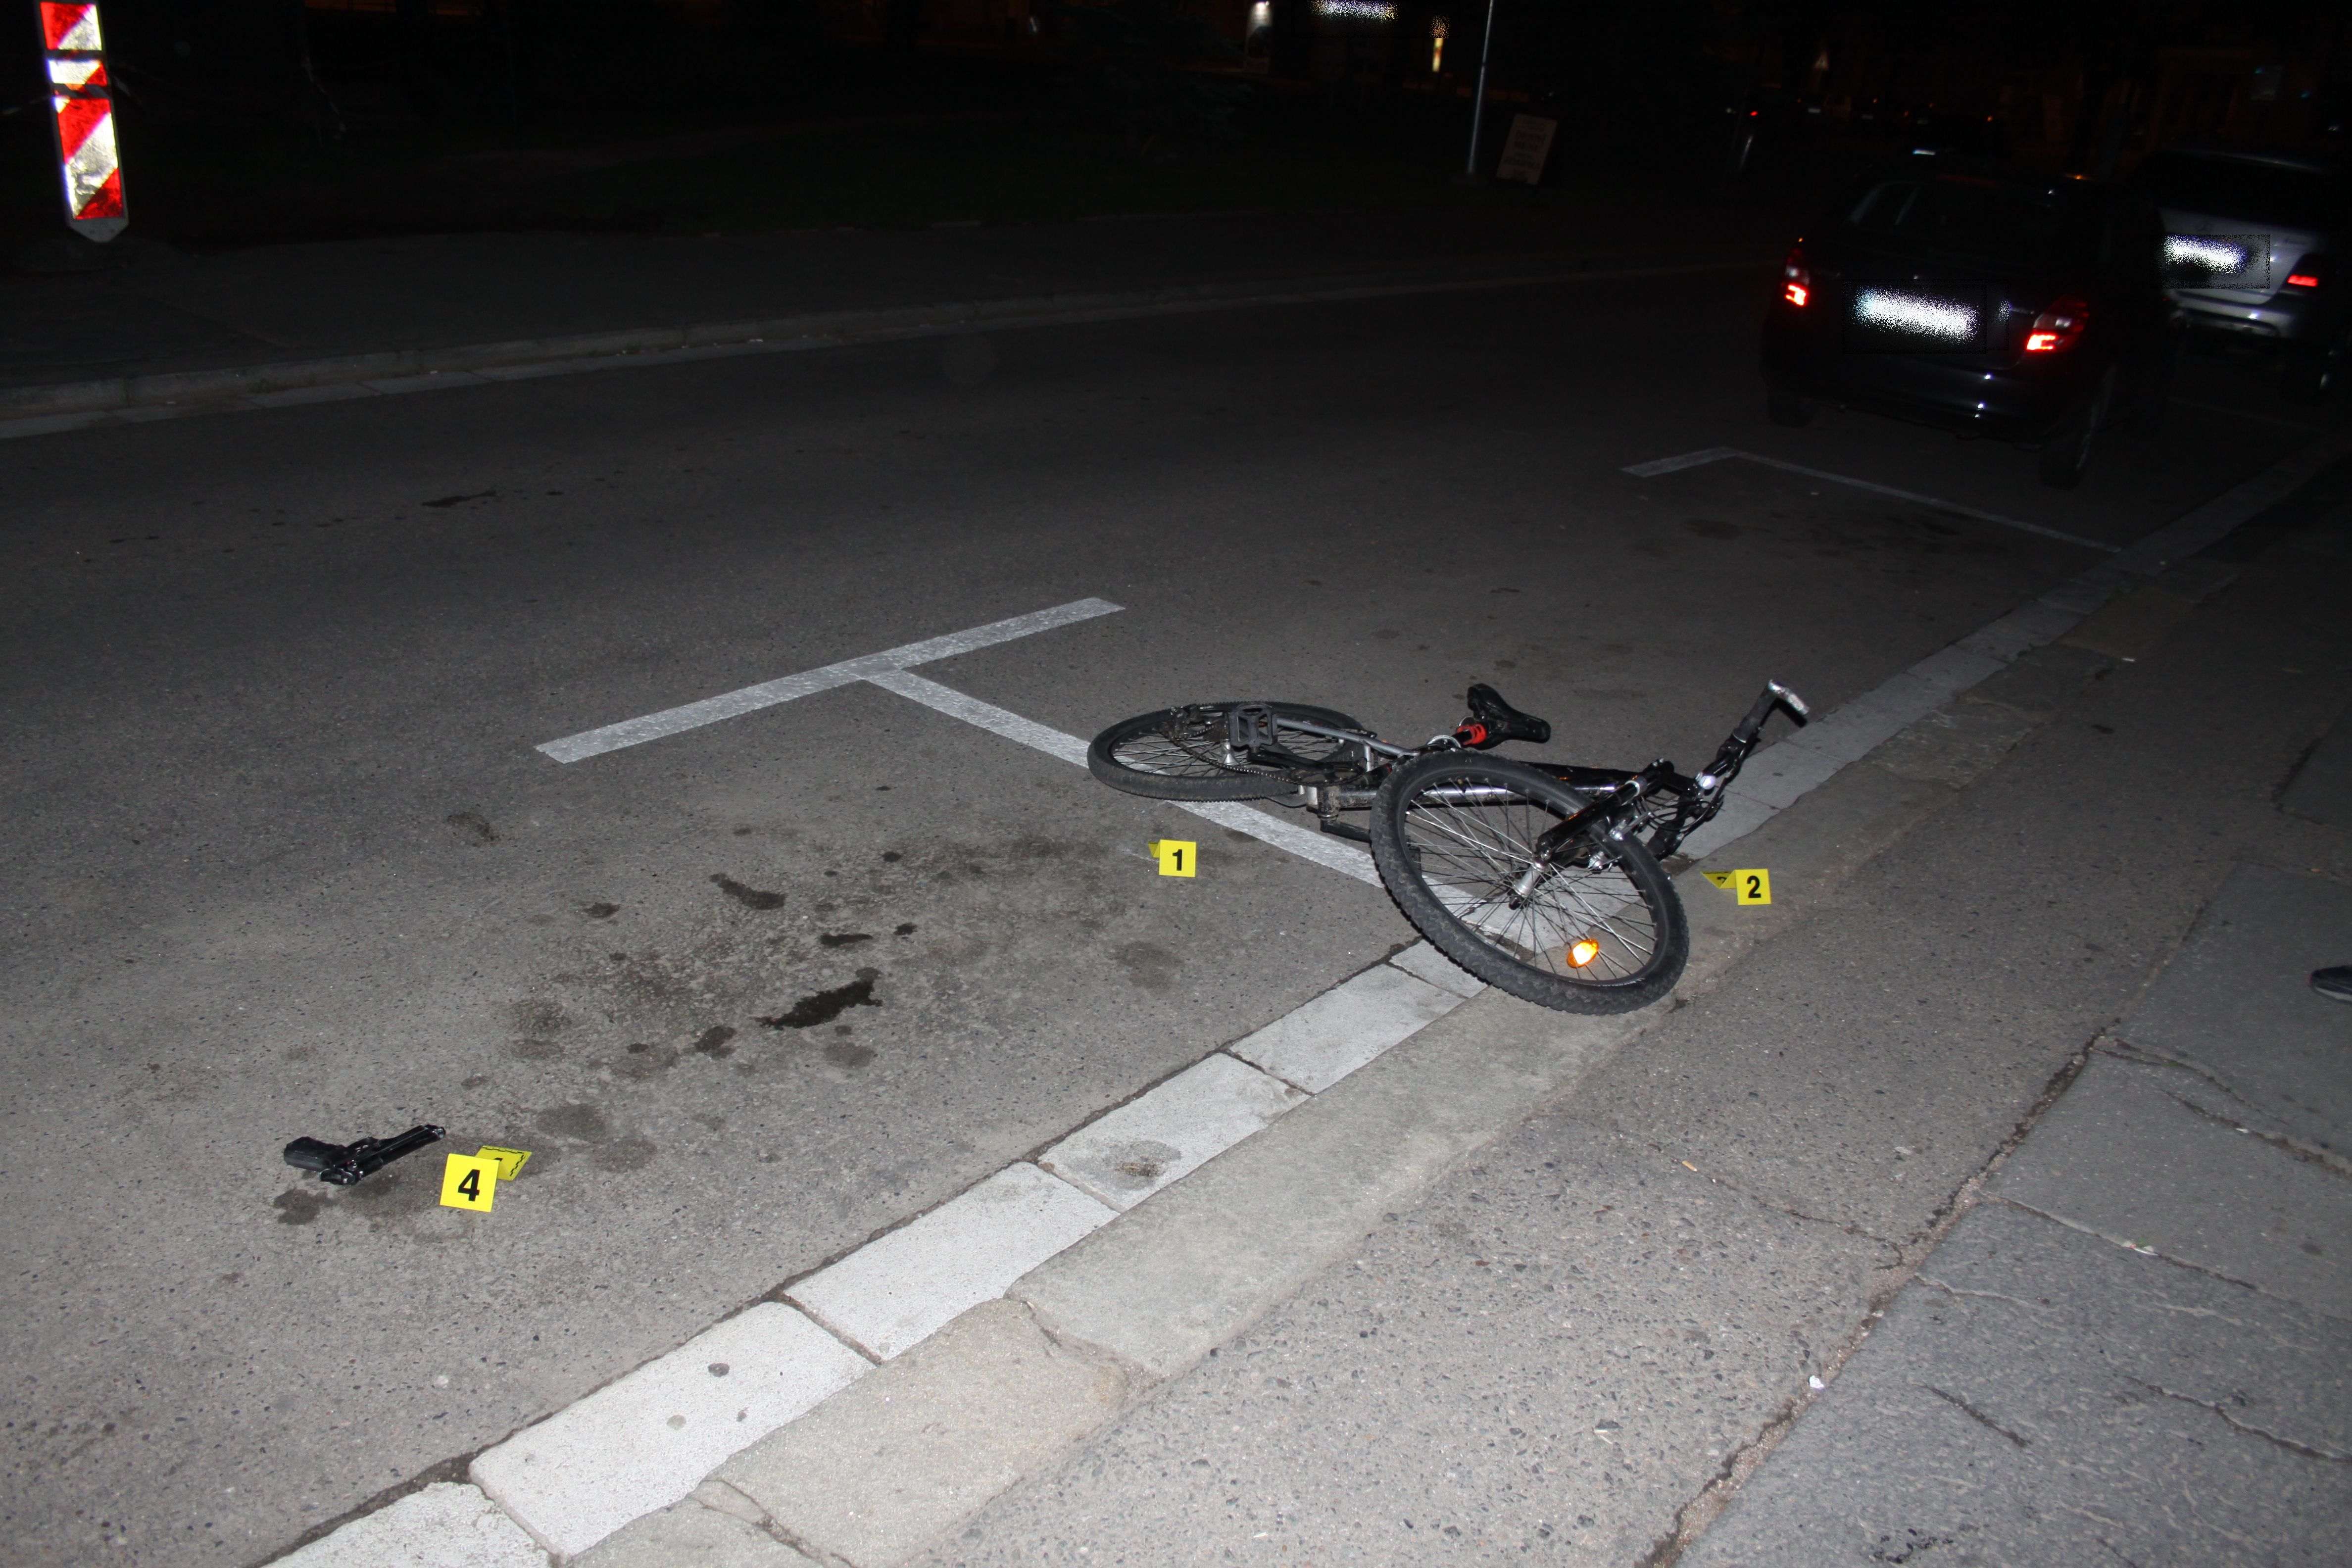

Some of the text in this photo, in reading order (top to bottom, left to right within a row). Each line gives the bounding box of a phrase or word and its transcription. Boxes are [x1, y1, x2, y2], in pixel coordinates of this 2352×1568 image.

[1172, 849, 1182, 871] 1
[1747, 875, 1762, 898] 2
[457, 1169, 481, 1202] 4
